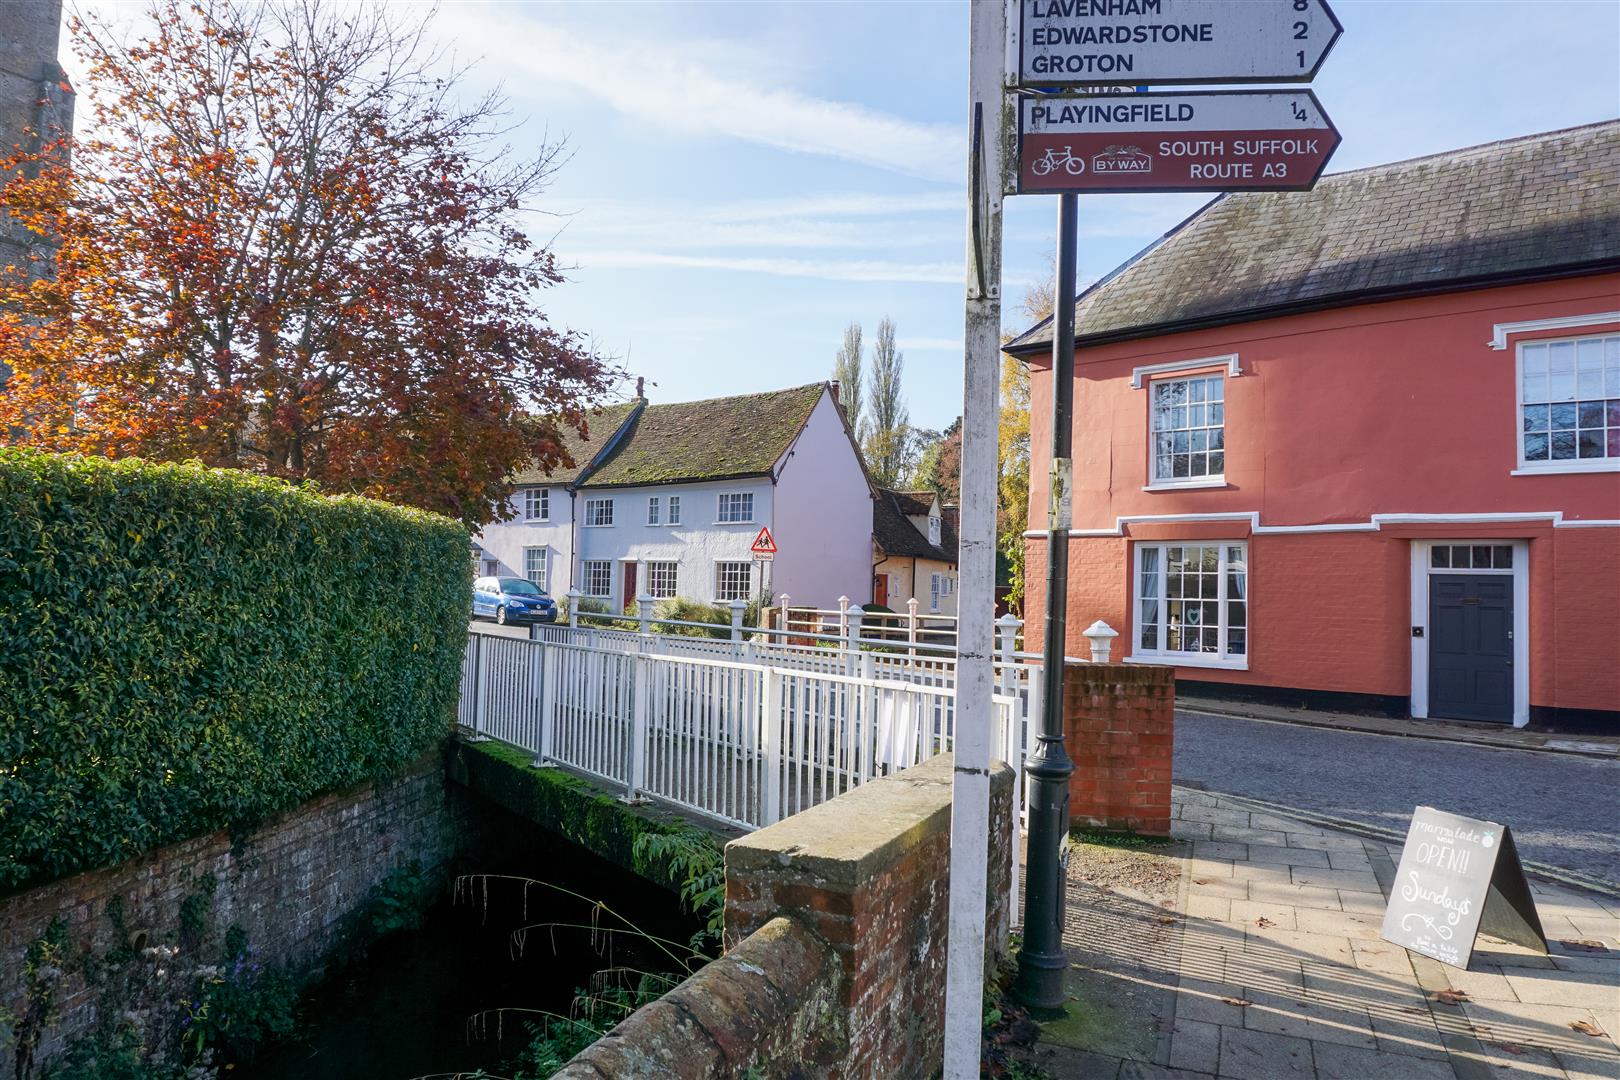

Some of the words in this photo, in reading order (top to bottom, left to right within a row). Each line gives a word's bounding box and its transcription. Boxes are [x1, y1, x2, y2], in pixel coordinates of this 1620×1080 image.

[1032, 0, 1161, 18] LAVENHAM
[1032, 23, 1213, 46] EDWARDSTONE
[1293, 21, 1308, 40] 2
[1031, 54, 1133, 73] GROTON
[1296, 50, 1305, 68] 1
[1031, 103, 1194, 125] PLAYINGFIELD
[1159, 140, 1225, 157] SOUTH
[1233, 139, 1318, 155] SUFFOLK
[1190, 163, 1253, 179] ROUTE
[1262, 162, 1287, 178] A3
[1401, 870, 1472, 925] Sundays
